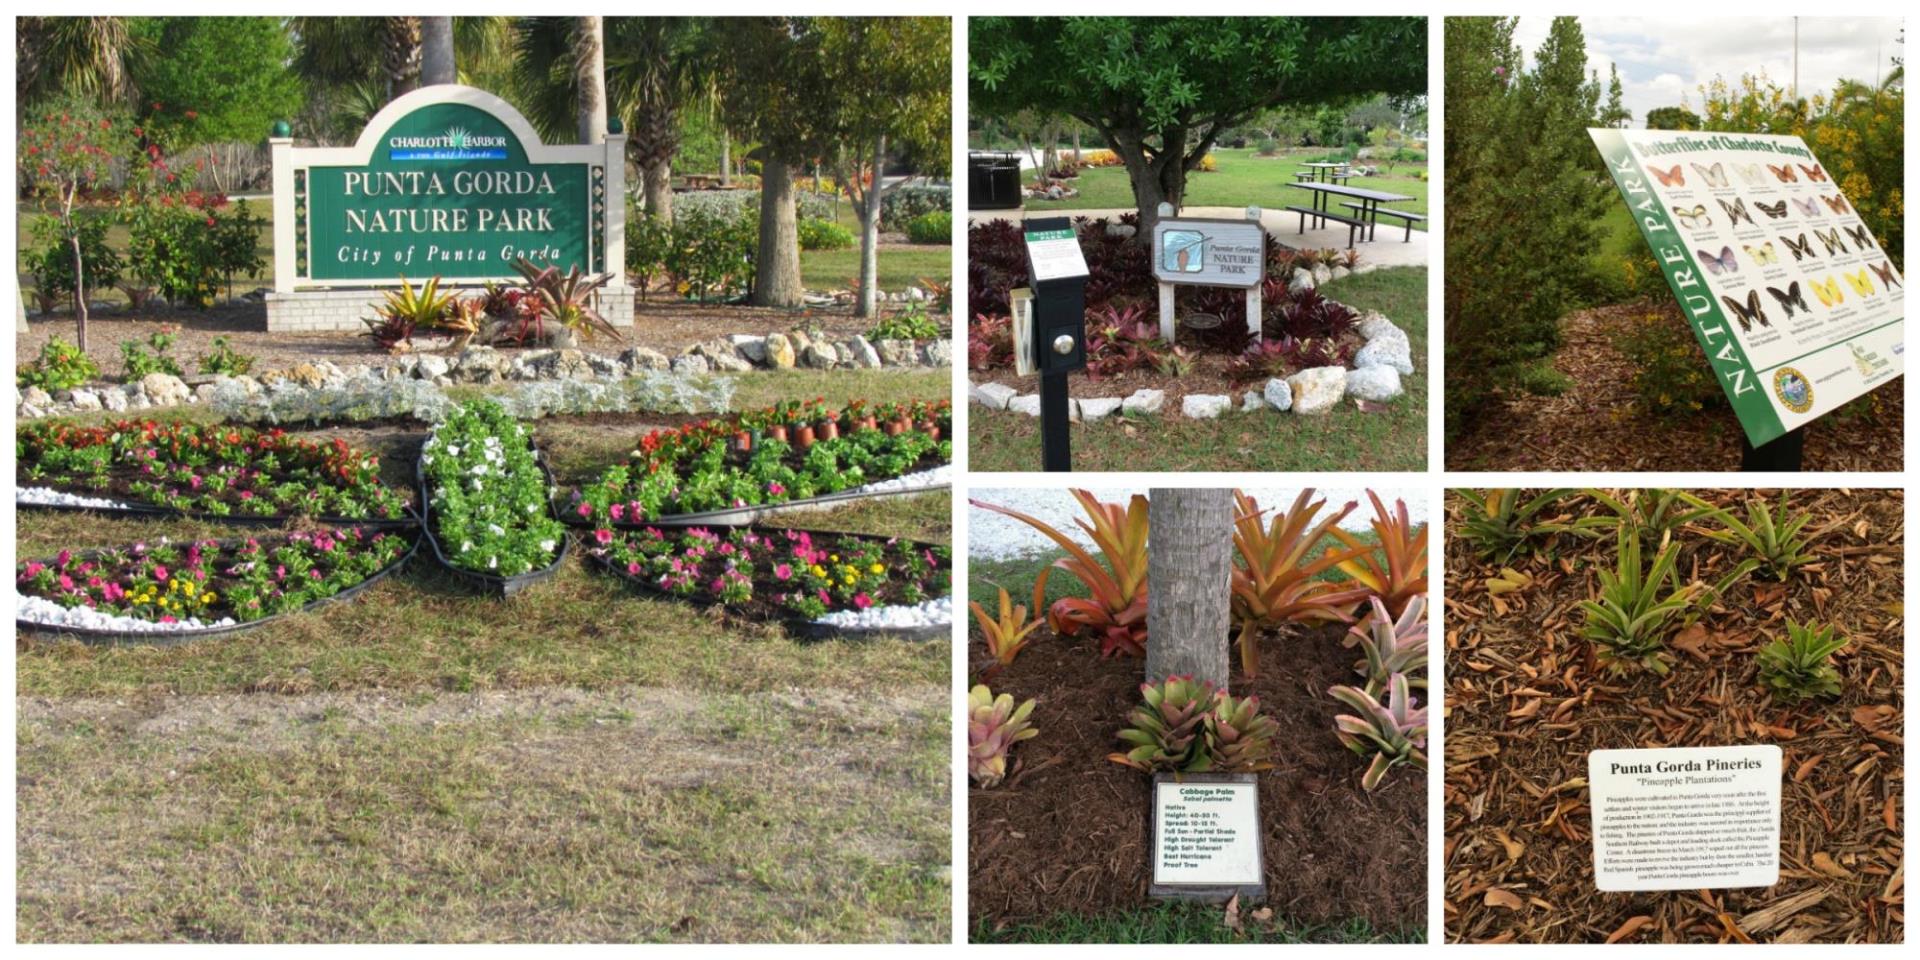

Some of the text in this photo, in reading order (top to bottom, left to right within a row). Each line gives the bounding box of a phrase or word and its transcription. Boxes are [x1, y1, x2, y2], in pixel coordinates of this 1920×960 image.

[390, 136, 506, 148] CHARLOTTE HARBOR
[1632, 136, 1812, 160] Butterflies of Charlotte County
[344, 170, 556, 196] PUNTA GORDA
[1612, 156, 1670, 233] PARK
[346, 208, 555, 233] NATURE PARK
[338, 245, 560, 265] City of Punta Gorda
[1214, 254, 1254, 264] NATURE
[1220, 264, 1246, 274] PARK
[1660, 244, 1756, 398] NATURE
[1611, 758, 1762, 774] Punta Gorda Pineries
[1636, 774, 1736, 787] "Pineapple Plantations"
